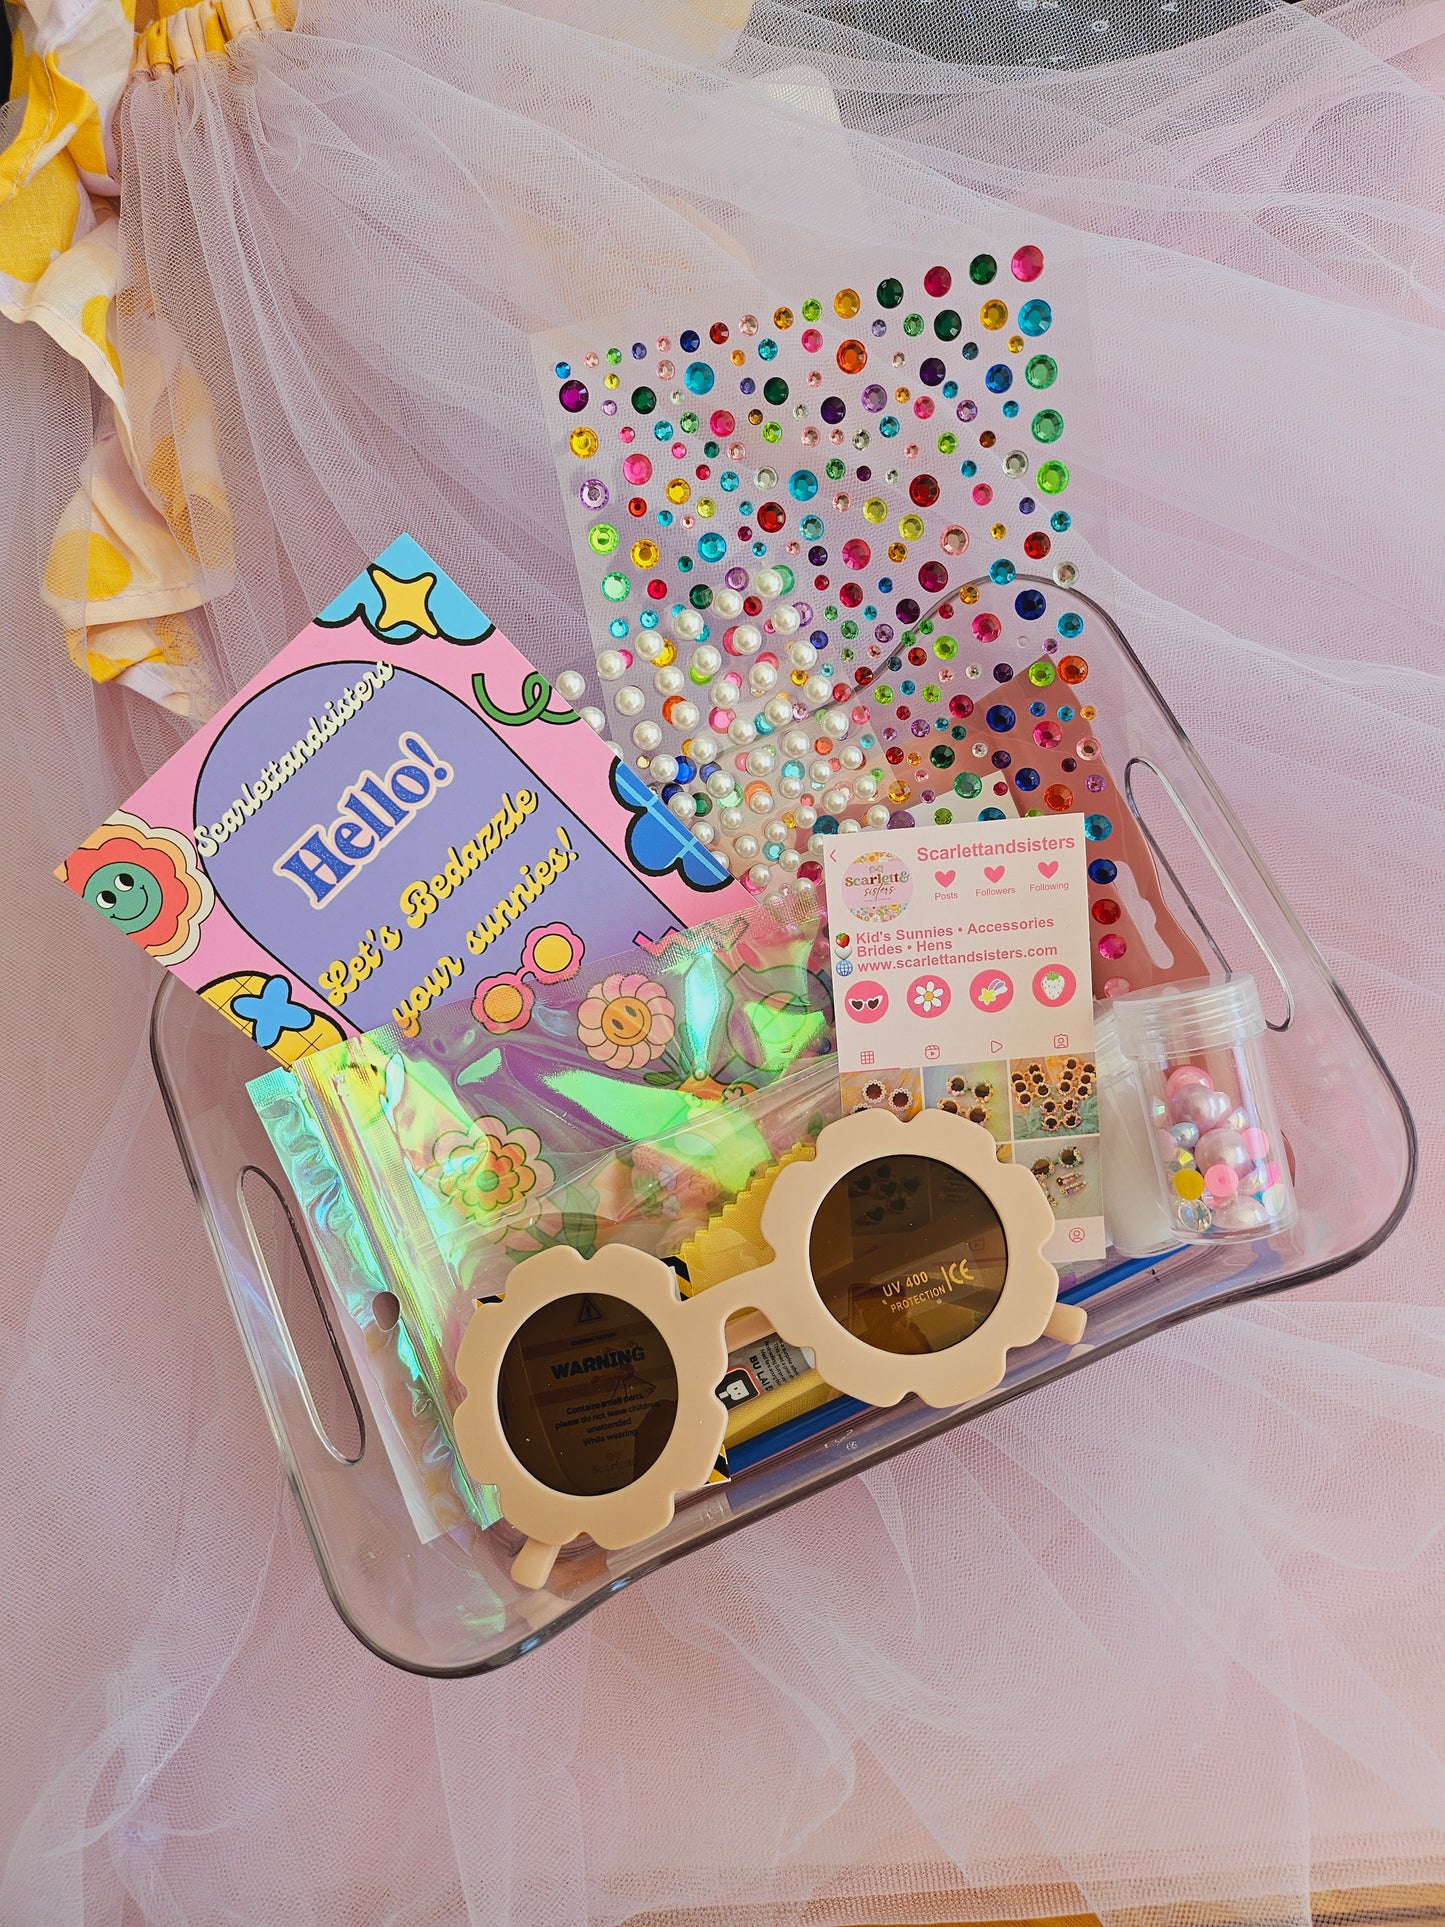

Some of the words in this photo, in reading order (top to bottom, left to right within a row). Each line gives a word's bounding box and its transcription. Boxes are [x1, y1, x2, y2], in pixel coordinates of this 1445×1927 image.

[194, 661, 395, 857] Scarlettandsisters
[278, 736, 449, 904] Hello!
[917, 837, 1075, 862] Scarlettandsisters
[318, 926, 402, 1006] Let's
[400, 789, 538, 929] Bedazzle
[934, 891, 959, 901] Posts
[975, 887, 1016, 897] Followers
[1029, 882, 1070, 893] Following
[392, 955, 464, 1038] your
[466, 826, 579, 955] sunnies!
[856, 931, 892, 944] Kid's
[896, 926, 954, 941] Sunnies
[967, 917, 1055, 935] Accessories
[857, 944, 903, 958] Brides
[916, 940, 953, 953] Hens
[857, 945, 1058, 973] www.scarlettandsisters.com
[882, 1280, 901, 1297] UV
[905, 1271, 929, 1289] 400
[948, 1258, 975, 1285] CE
[890, 1284, 947, 1313] PROTECTION
[550, 1347, 645, 1380] WARNING
[749, 1355, 761, 1370] BU
[756, 1370, 771, 1386] LAI
[581, 1414, 592, 1425] do
[593, 1411, 606, 1422] not
[586, 1417, 632, 1434] unattended
